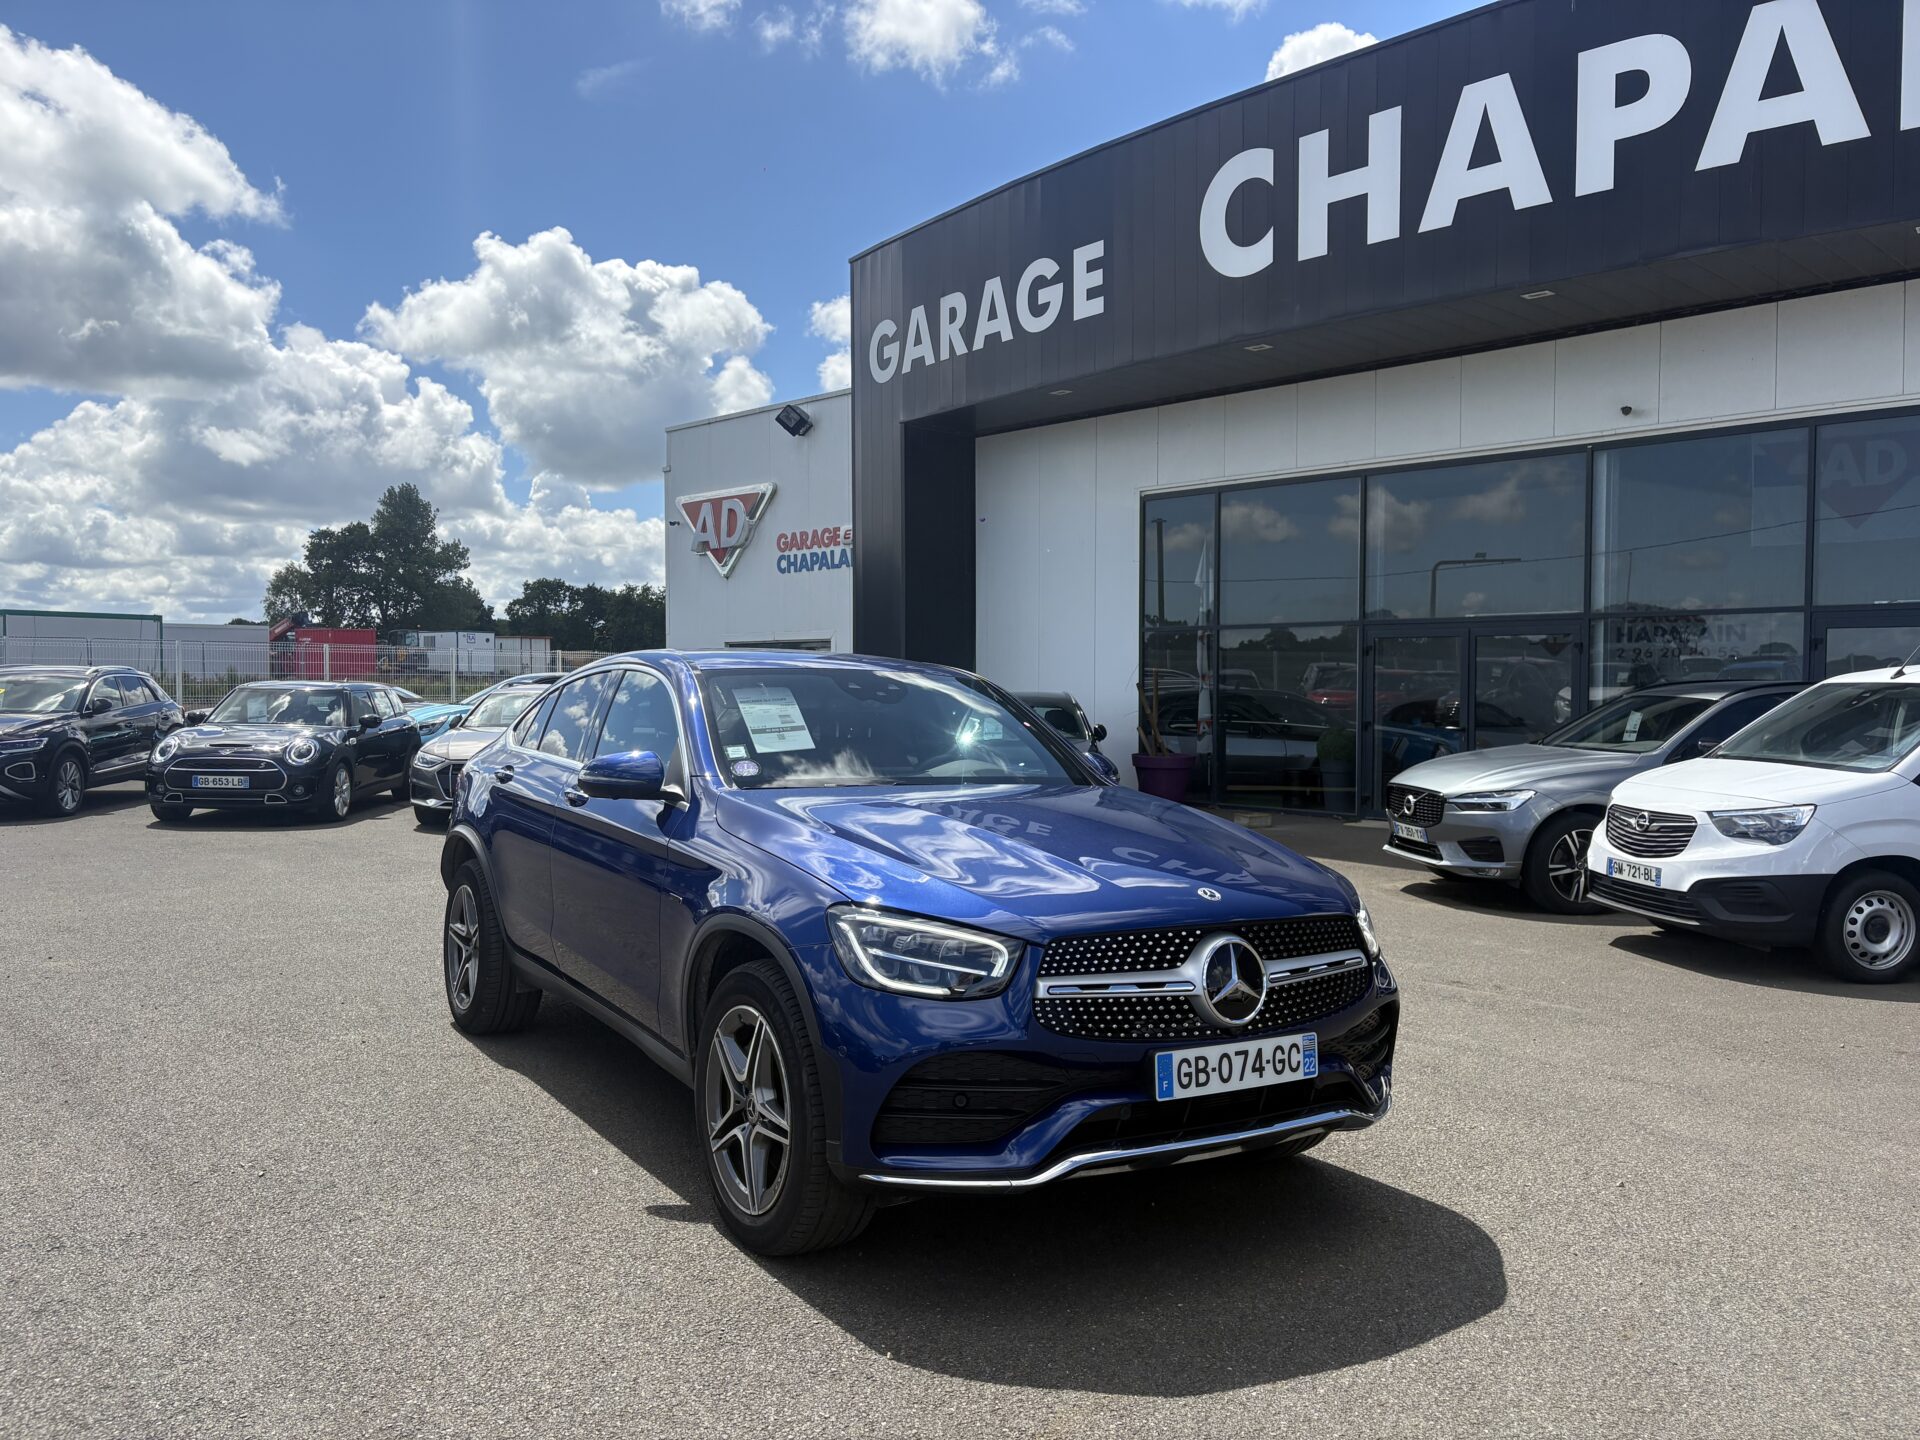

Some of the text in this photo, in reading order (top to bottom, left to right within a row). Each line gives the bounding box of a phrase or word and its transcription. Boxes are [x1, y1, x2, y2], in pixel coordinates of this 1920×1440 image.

[869, 239, 1105, 384] GARAGE
[691, 498, 748, 553] AD
[776, 526, 841, 553] GARAGE
[1613, 861, 1656, 882] GM-721-BL
[1162, 1042, 1316, 1091] F GB-074-GC 22
